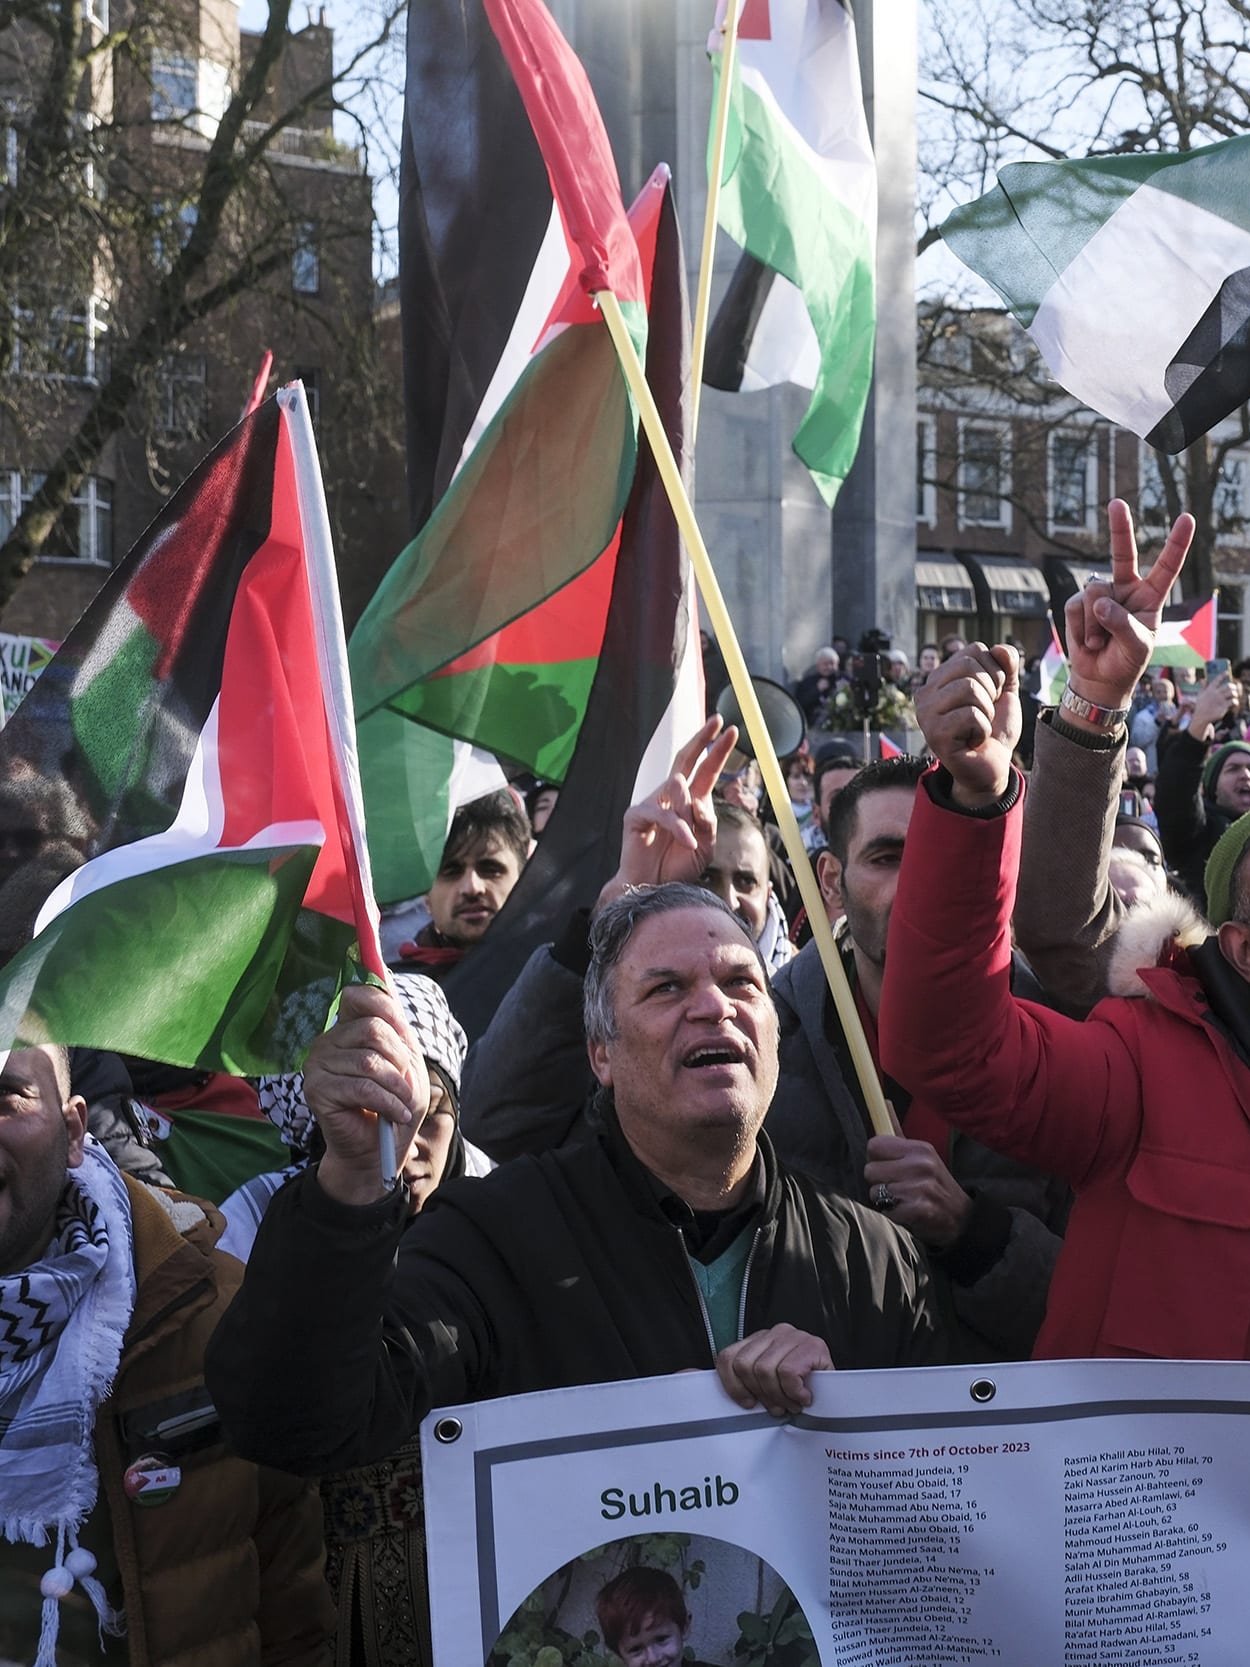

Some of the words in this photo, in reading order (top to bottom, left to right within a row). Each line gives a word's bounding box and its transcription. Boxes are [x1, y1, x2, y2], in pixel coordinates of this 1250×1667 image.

[825, 1449, 869, 1460] Victims
[873, 1450, 905, 1460] since
[909, 1448, 929, 1458] 7th
[933, 1446, 945, 1456] of
[949, 1444, 998, 1455] October
[1002, 1442, 1030, 1453] 2023
[1065, 1455, 1097, 1466] Rasmia
[1100, 1451, 1124, 1461] Khalil
[1127, 1449, 1145, 1458] Abu
[828, 1467, 851, 1477] Safaa
[855, 1469, 913, 1478] Muhammad
[959, 1465, 968, 1473] 19
[1064, 1467, 1087, 1478] Abed
[1090, 1466, 1098, 1474] Al
[1102, 1463, 1128, 1473] Karim
[1131, 1459, 1153, 1469] Harb
[1155, 1458, 1173, 1466] Abu
[829, 1478, 857, 1489] Karam
[860, 1481, 892, 1489] Yousef
[952, 1477, 962, 1485] 18
[1065, 1480, 1083, 1490] Zaki
[1086, 1477, 1117, 1487] Nassar
[1159, 1469, 1169, 1477] 70
[600, 1474, 740, 1521] Suhaib
[829, 1488, 857, 1500] Marah
[860, 1492, 918, 1500] Muhammad
[1065, 1503, 1102, 1513] Masarra
[1105, 1498, 1128, 1508] Abed
[1185, 1489, 1195, 1497] 64
[829, 1499, 846, 1511] Saja
[850, 1503, 907, 1512] Muhammad
[967, 1500, 977, 1508] 16
[830, 1511, 855, 1522] Malak
[859, 1515, 916, 1523] Muhammad
[976, 1512, 986, 1520] 16
